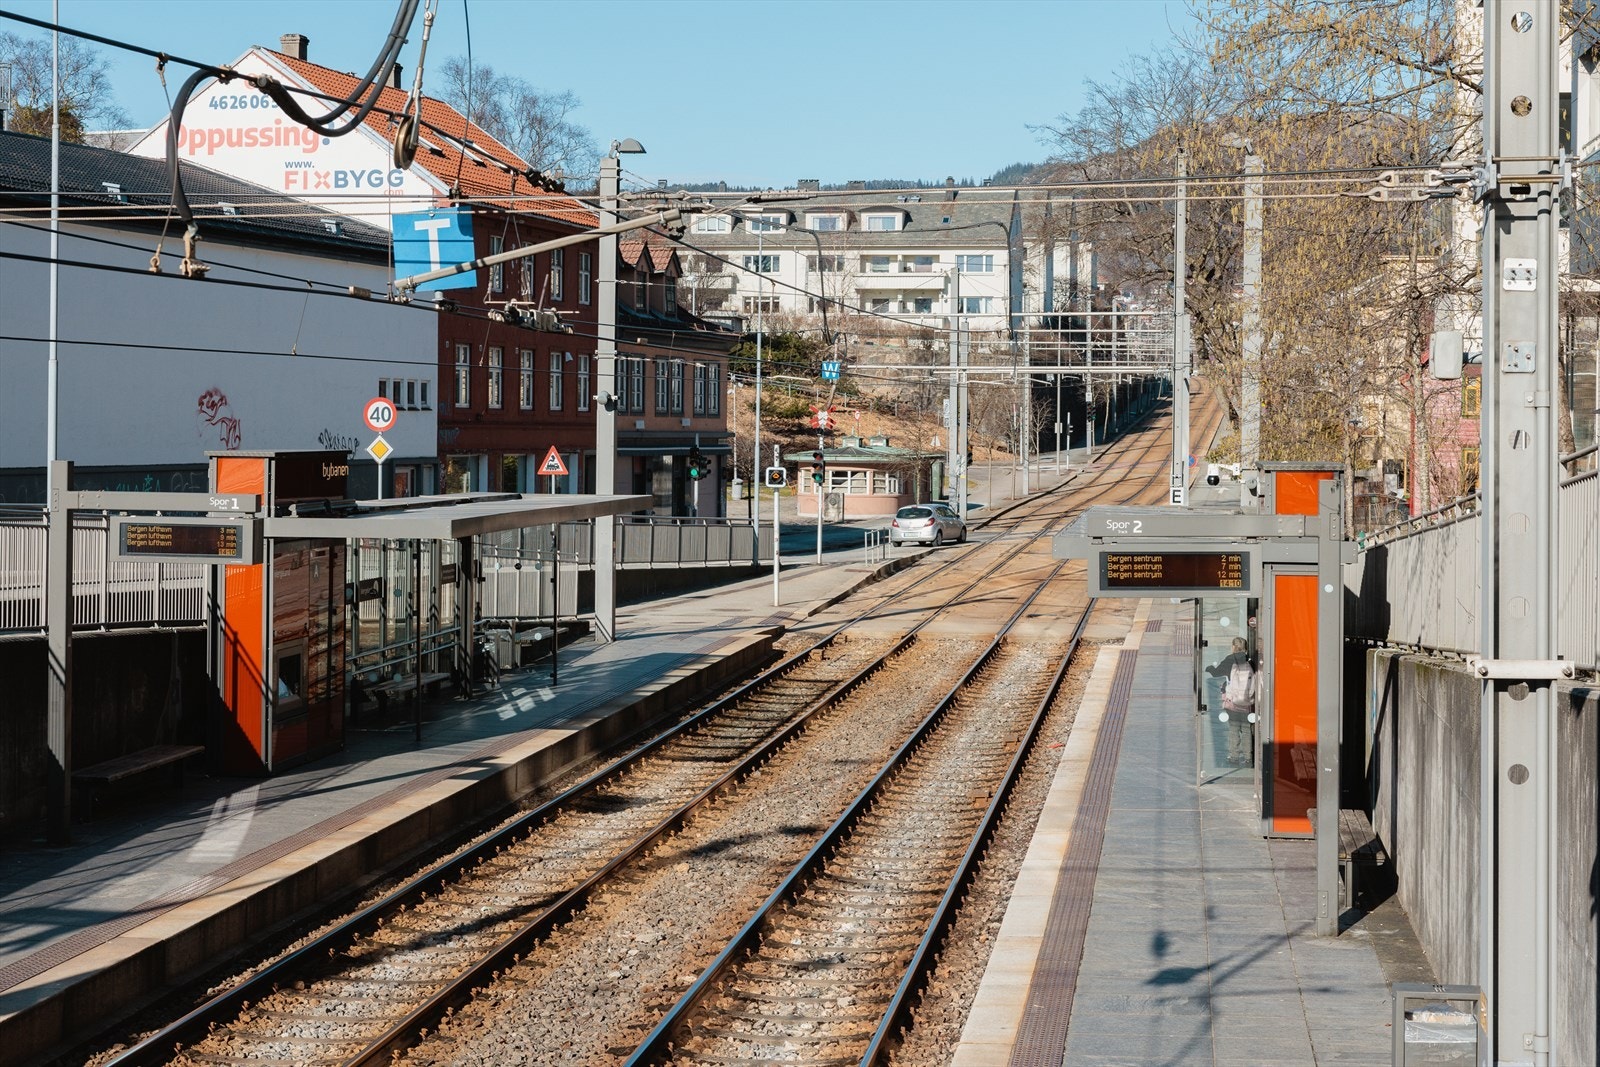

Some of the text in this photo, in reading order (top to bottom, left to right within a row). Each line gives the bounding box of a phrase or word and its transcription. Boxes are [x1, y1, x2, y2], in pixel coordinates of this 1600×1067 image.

[284, 161, 315, 169] www.
[284, 169, 404, 190] FIXBYGG
[414, 218, 451, 272] T
[823, 363, 839, 377] W
[370, 406, 392, 423] 40
[322, 462, 349, 480] bybanen
[1172, 489, 1181, 503] E
[209, 497, 240, 510] Spor 1
[1106, 519, 1142, 533] Spor 2
[1108, 554, 1132, 563] Bergen
[1108, 562, 1132, 571] Bergen
[1108, 571, 1132, 580] Bergen
[1220, 580, 1242, 588] 14:10
